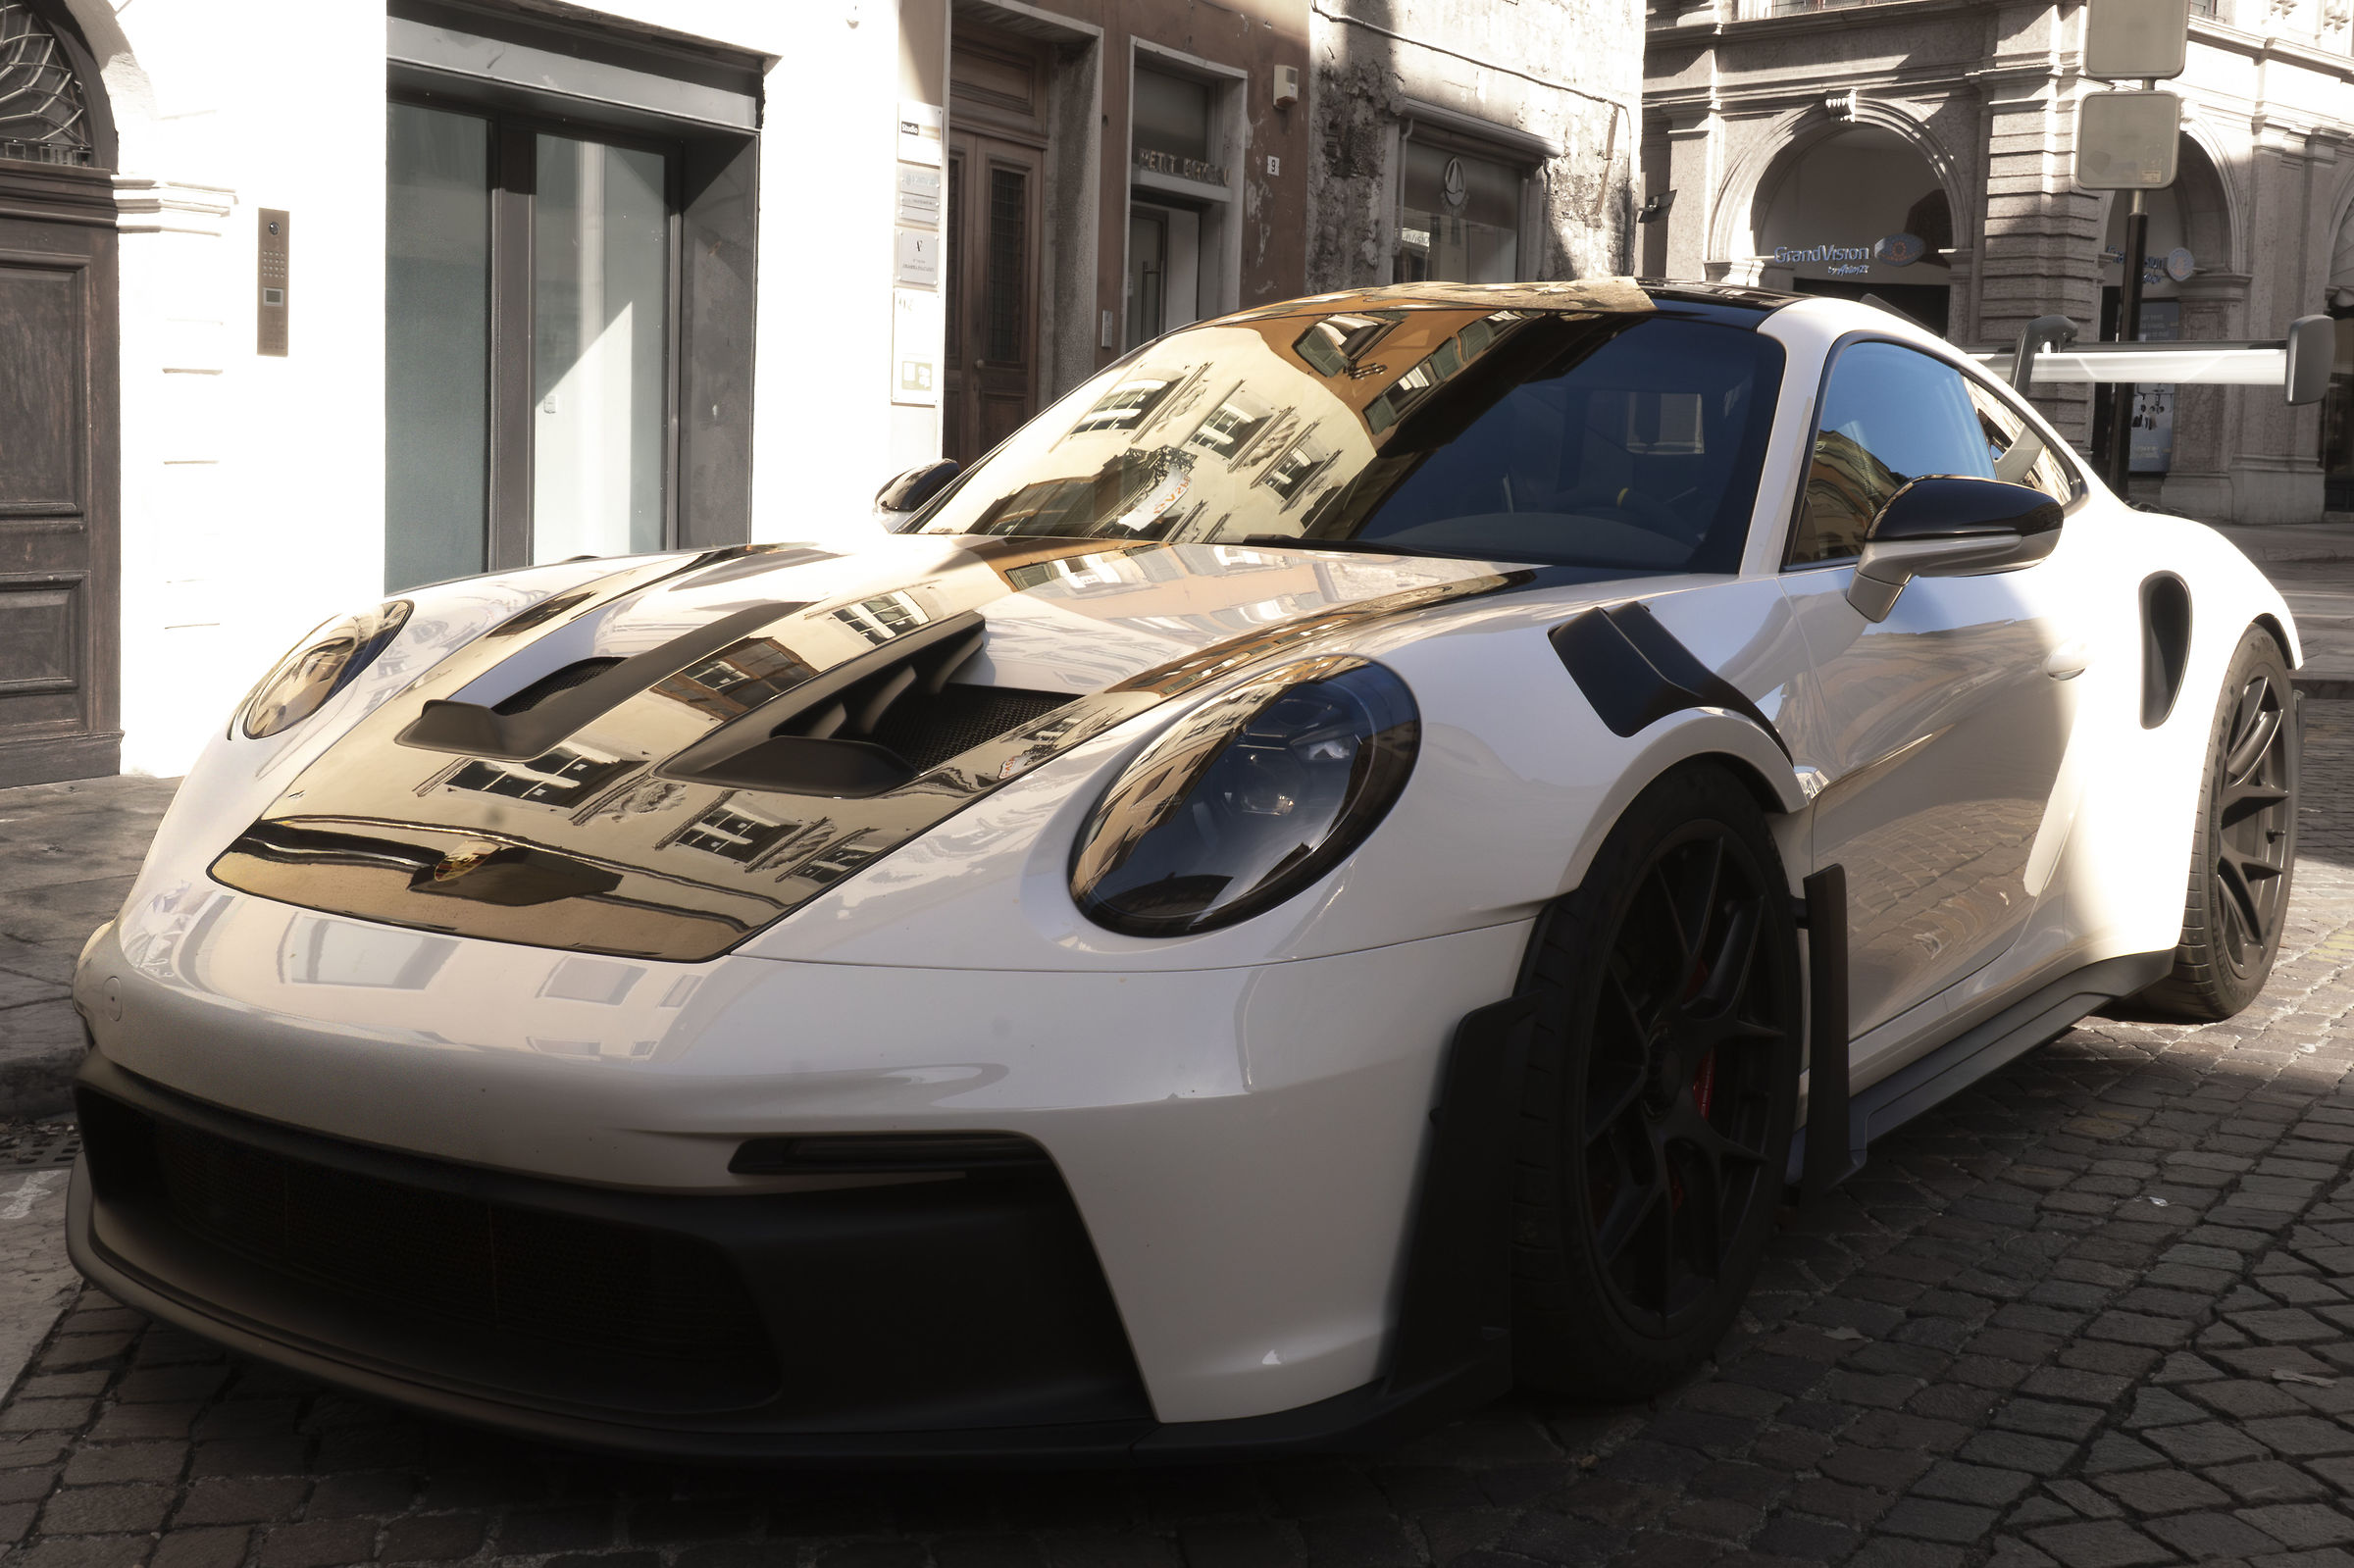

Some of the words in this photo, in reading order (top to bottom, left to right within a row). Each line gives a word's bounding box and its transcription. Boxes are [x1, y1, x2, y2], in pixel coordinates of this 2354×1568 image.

[902, 124, 918, 134] Studio
[1271, 159, 1276, 173] 9
[1774, 244, 1869, 264] GrandVision
